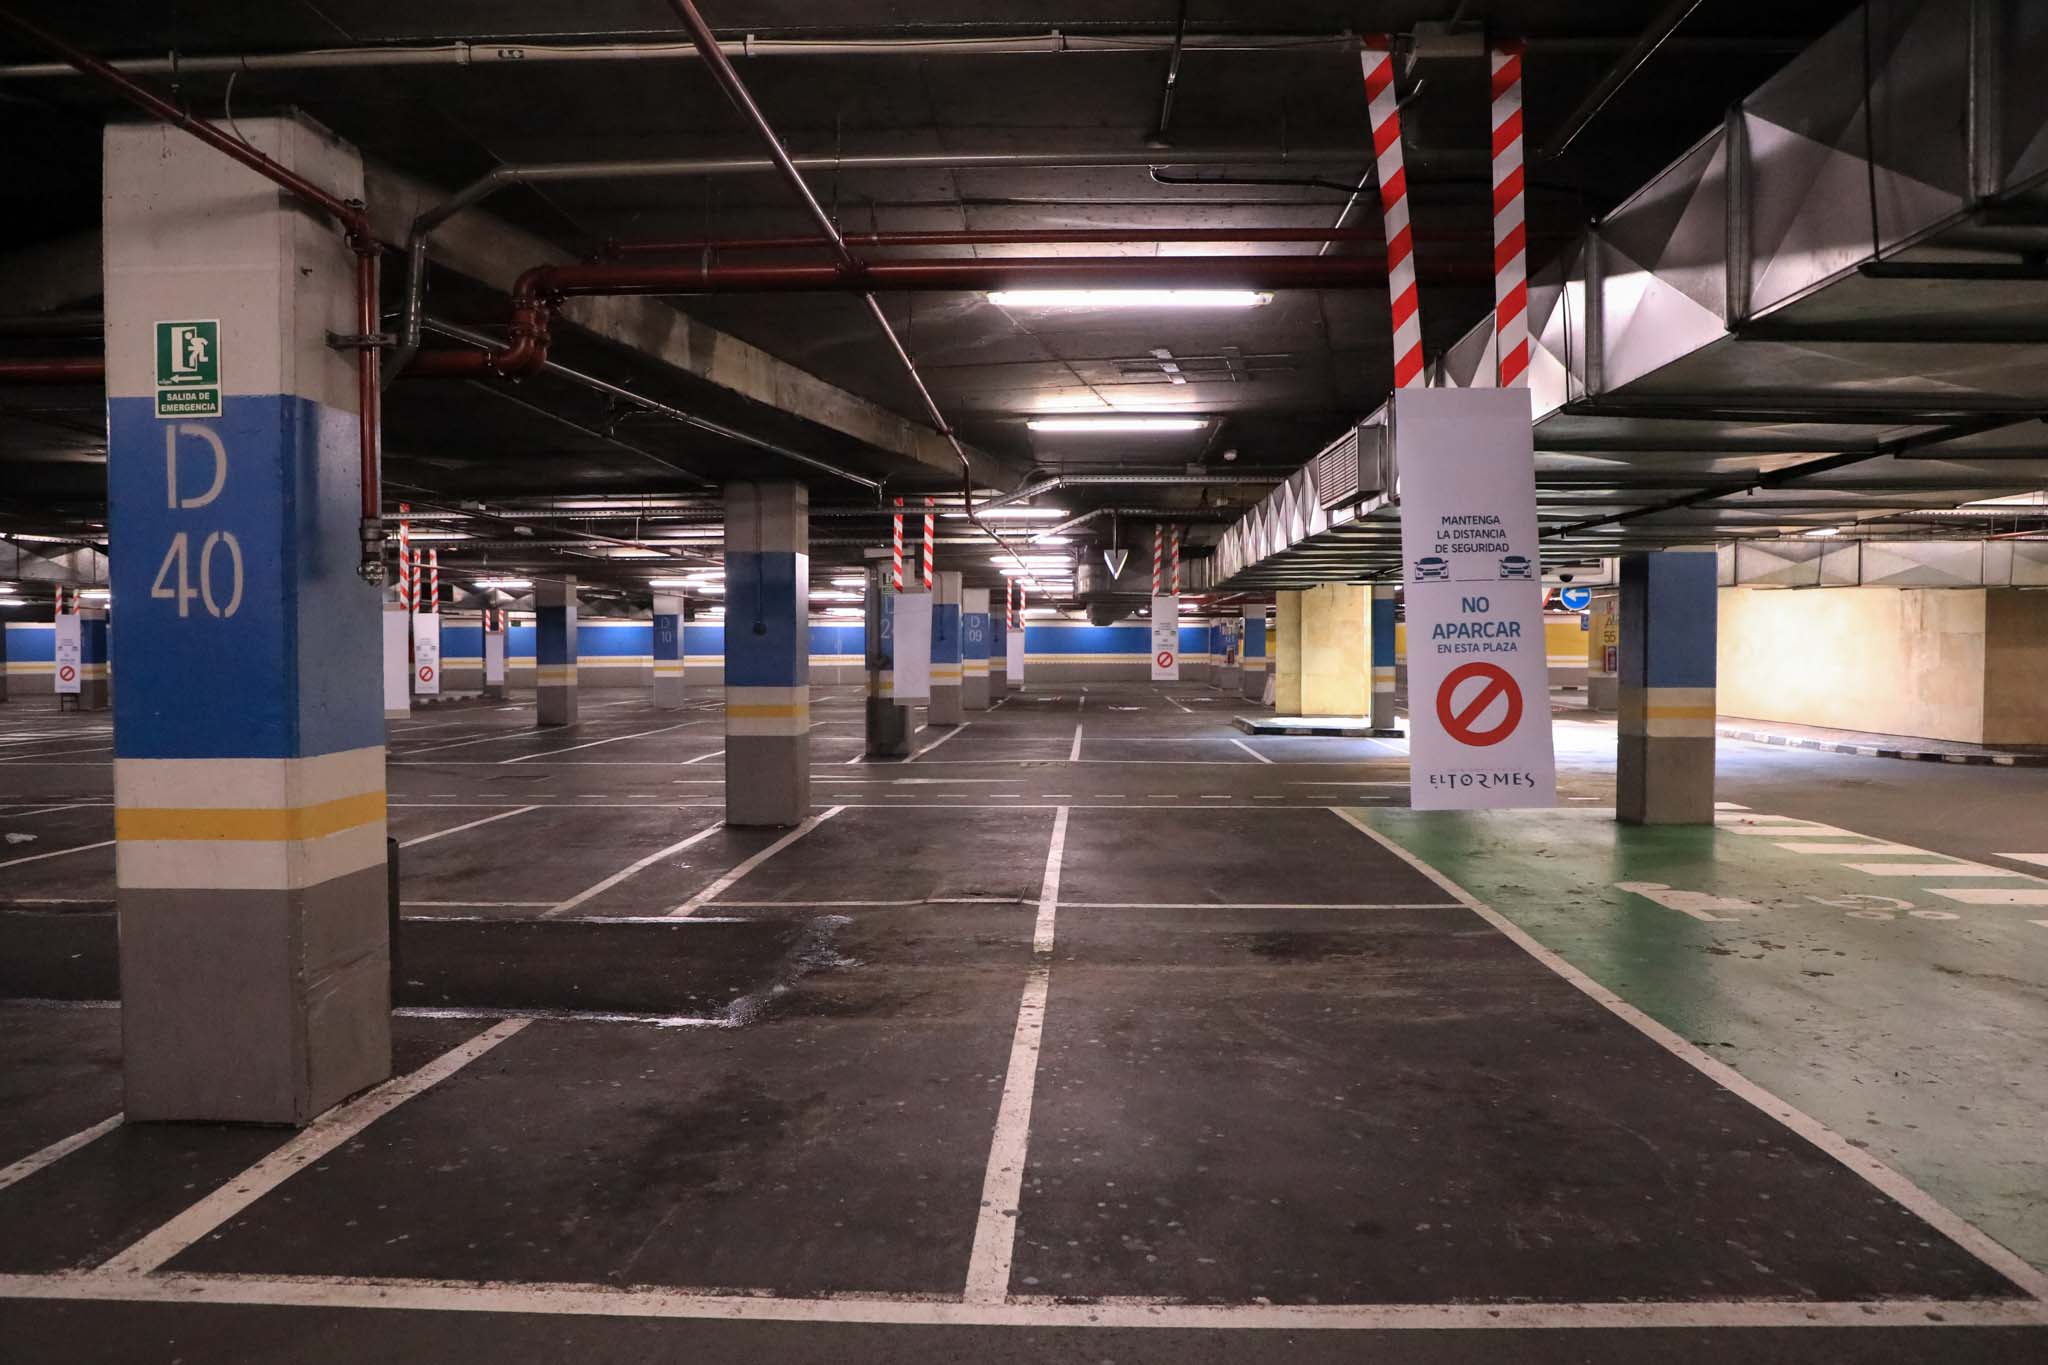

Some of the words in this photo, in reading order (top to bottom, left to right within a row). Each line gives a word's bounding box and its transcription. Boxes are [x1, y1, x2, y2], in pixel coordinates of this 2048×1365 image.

[166, 393, 197, 401] SALIDA
[198, 392, 210, 400] DE
[161, 402, 216, 412] EMERGENCIA
[167, 425, 227, 509] D
[1441, 515, 1500, 525] MANTENGA
[1436, 530, 1451, 540] LA
[1453, 529, 1507, 540] DISTANCIA
[1435, 544, 1448, 554] DE
[1451, 543, 1510, 553] SEGURIDAD
[151, 531, 244, 618] 40
[1461, 596, 1490, 613] NO
[970, 615, 980, 628] D
[969, 629, 983, 642] 09
[1432, 621, 1521, 640] APARCAR
[662, 631, 672, 643] 10
[1437, 643, 1452, 654] EN
[1455, 643, 1481, 653] ESTA
[1483, 642, 1518, 652] PLAZA
